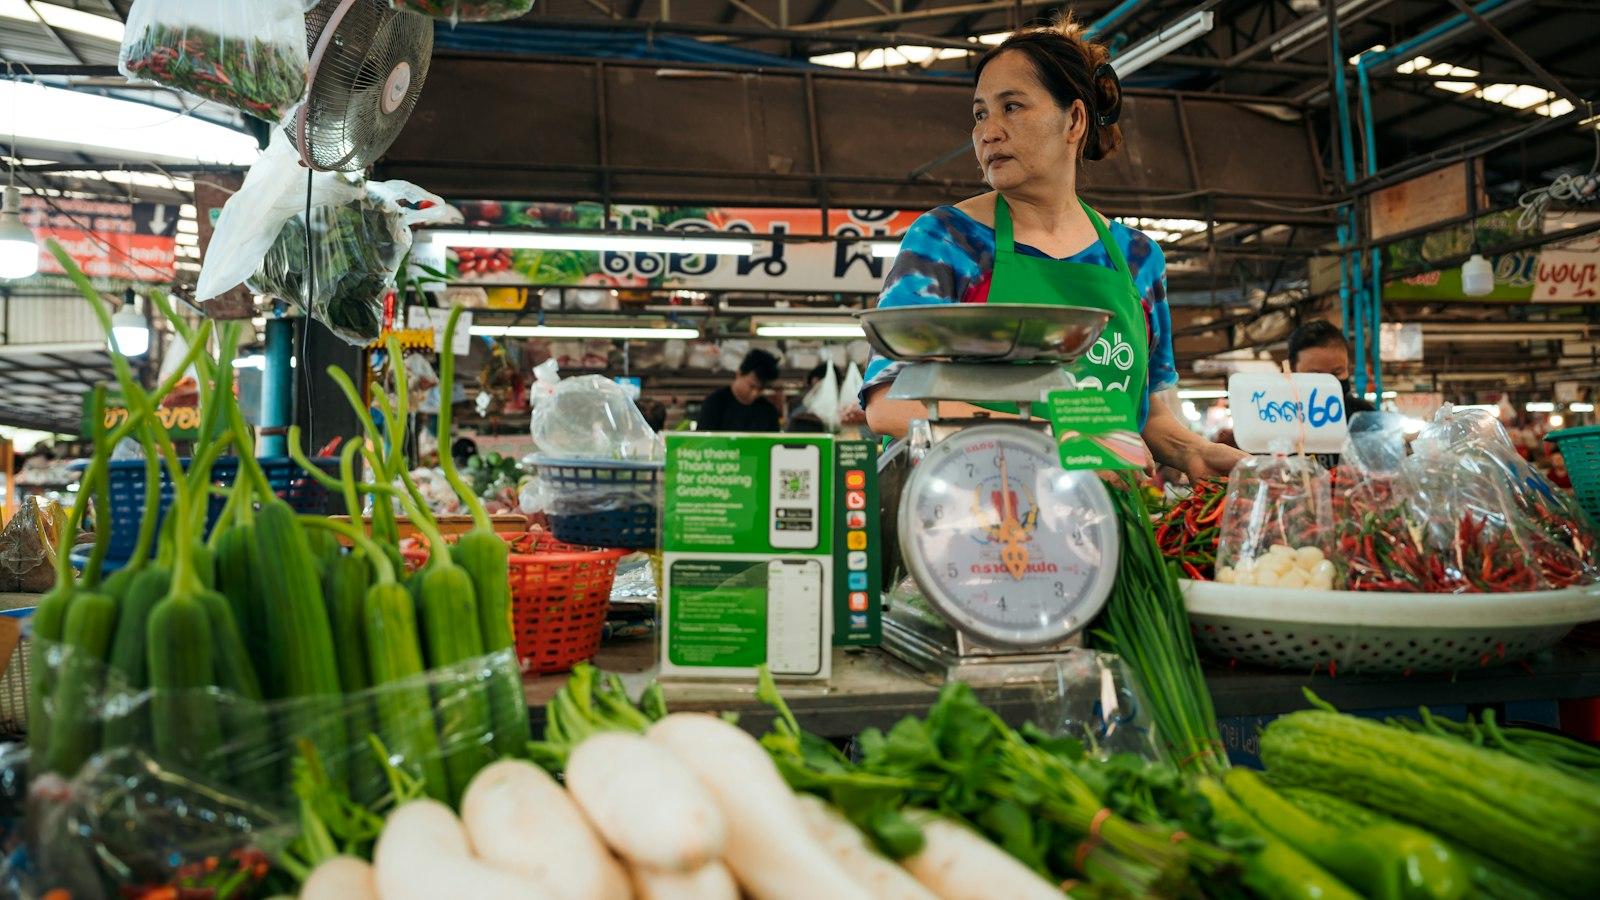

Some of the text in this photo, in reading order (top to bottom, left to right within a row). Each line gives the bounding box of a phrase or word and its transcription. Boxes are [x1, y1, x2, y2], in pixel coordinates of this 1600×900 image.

[1308, 387, 1343, 428] 60
[677, 447, 741, 461] Hey there!
[677, 460, 740, 475] Thank you
[965, 462, 975, 478] 7
[676, 473, 752, 489] for choosing
[947, 563, 959, 578] 5
[1054, 581, 1065, 598] 3
[996, 595, 1007, 612] 4
